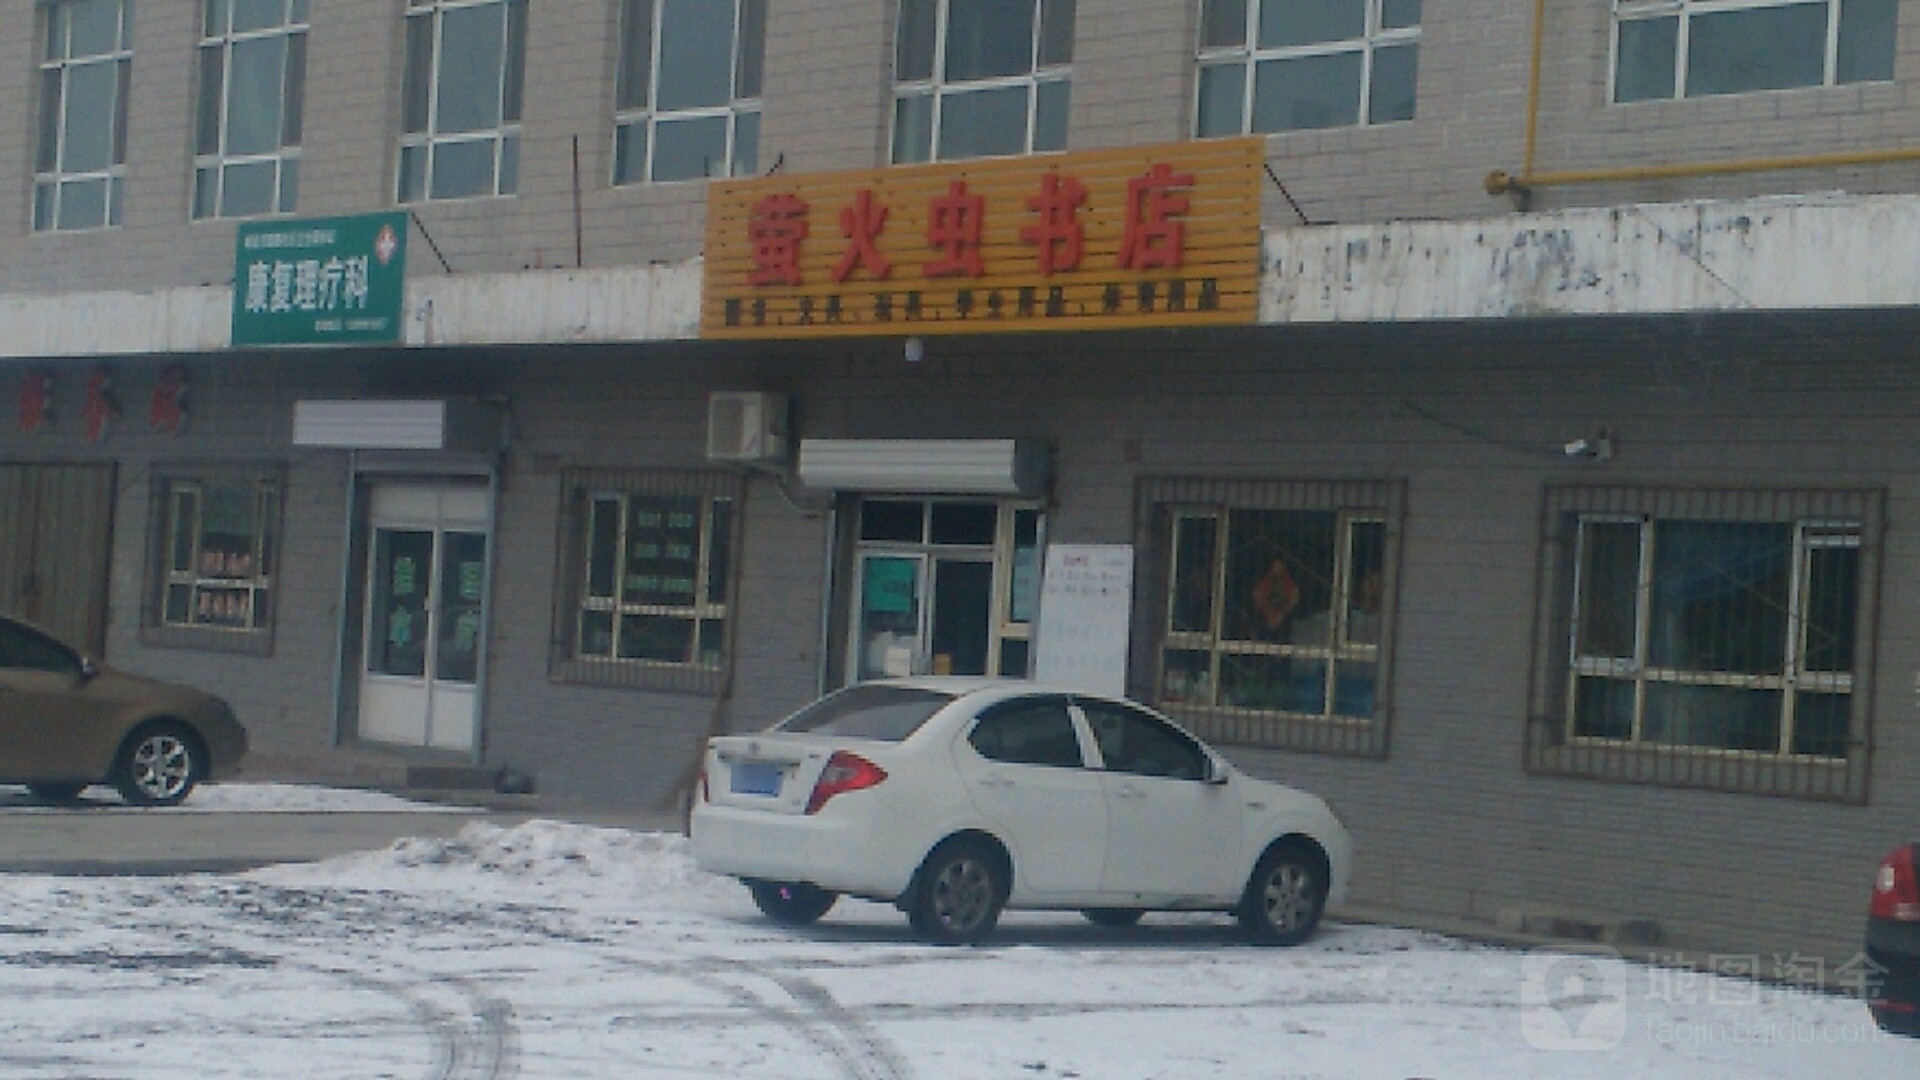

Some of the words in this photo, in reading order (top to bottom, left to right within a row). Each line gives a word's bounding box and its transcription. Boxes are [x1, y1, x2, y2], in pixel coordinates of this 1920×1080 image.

[747, 163, 1196, 287] 萤火虫书店
